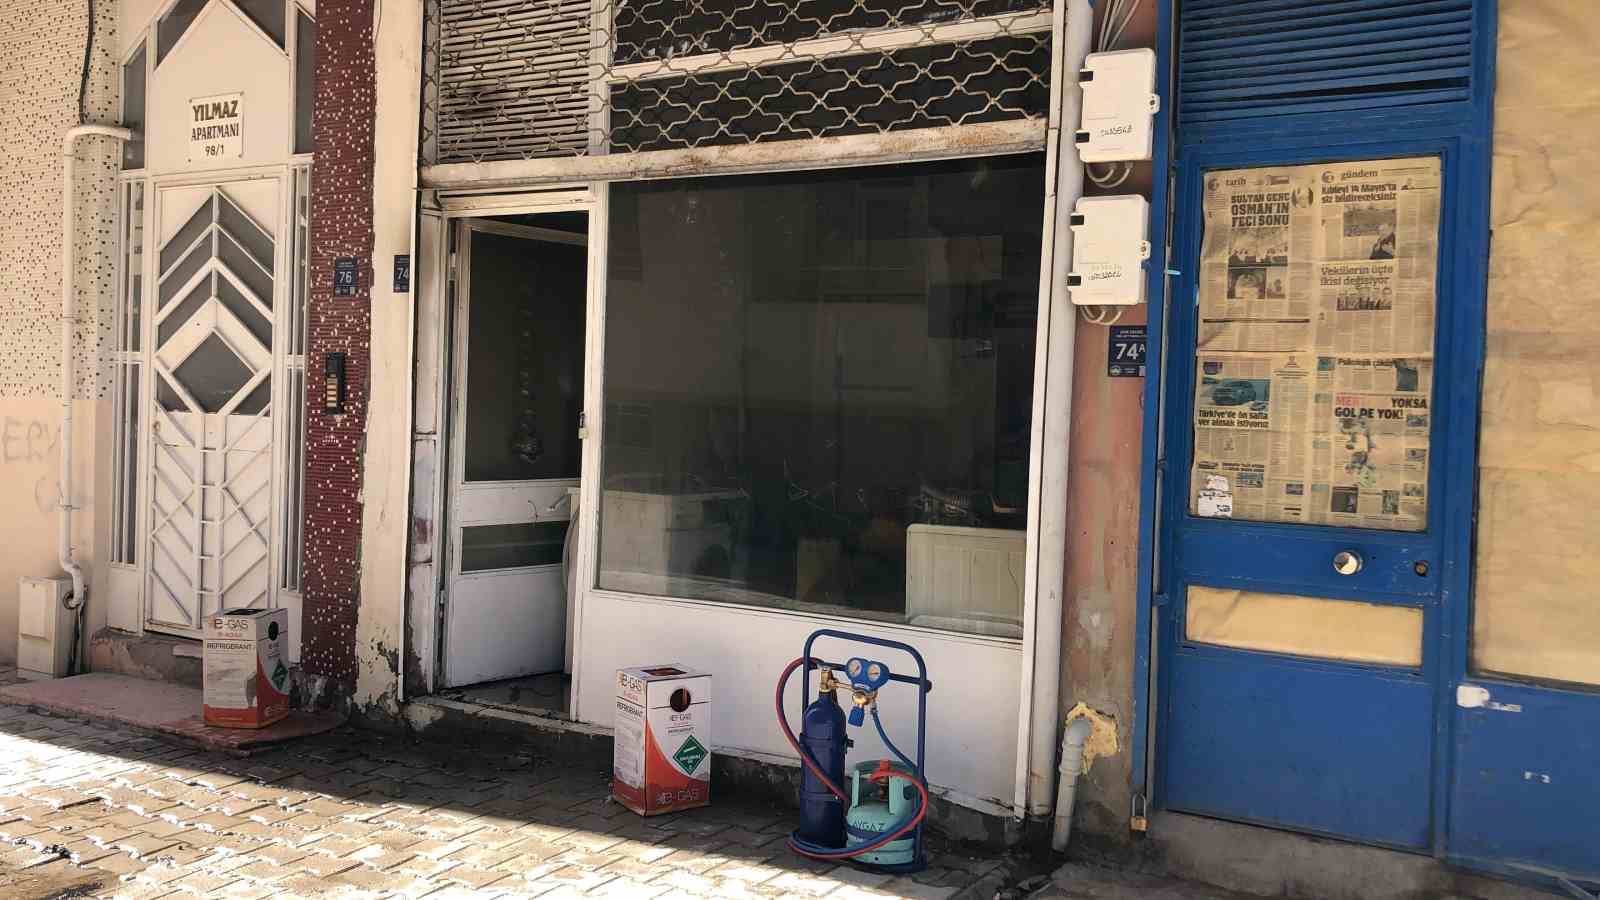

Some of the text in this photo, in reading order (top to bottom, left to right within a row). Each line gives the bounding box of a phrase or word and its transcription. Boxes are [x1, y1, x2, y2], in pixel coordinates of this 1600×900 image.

[192, 100, 238, 122] YILMAZ
[191, 123, 239, 141] APARTMANI
[205, 144, 224, 157] 98/1
[339, 271, 352, 284] 76
[1391, 398, 1428, 409] YOKSA
[1335, 408, 1358, 418] GOL
[1377, 409, 1405, 419] YOK!
[207, 643, 253, 651] REFRIGERANT
